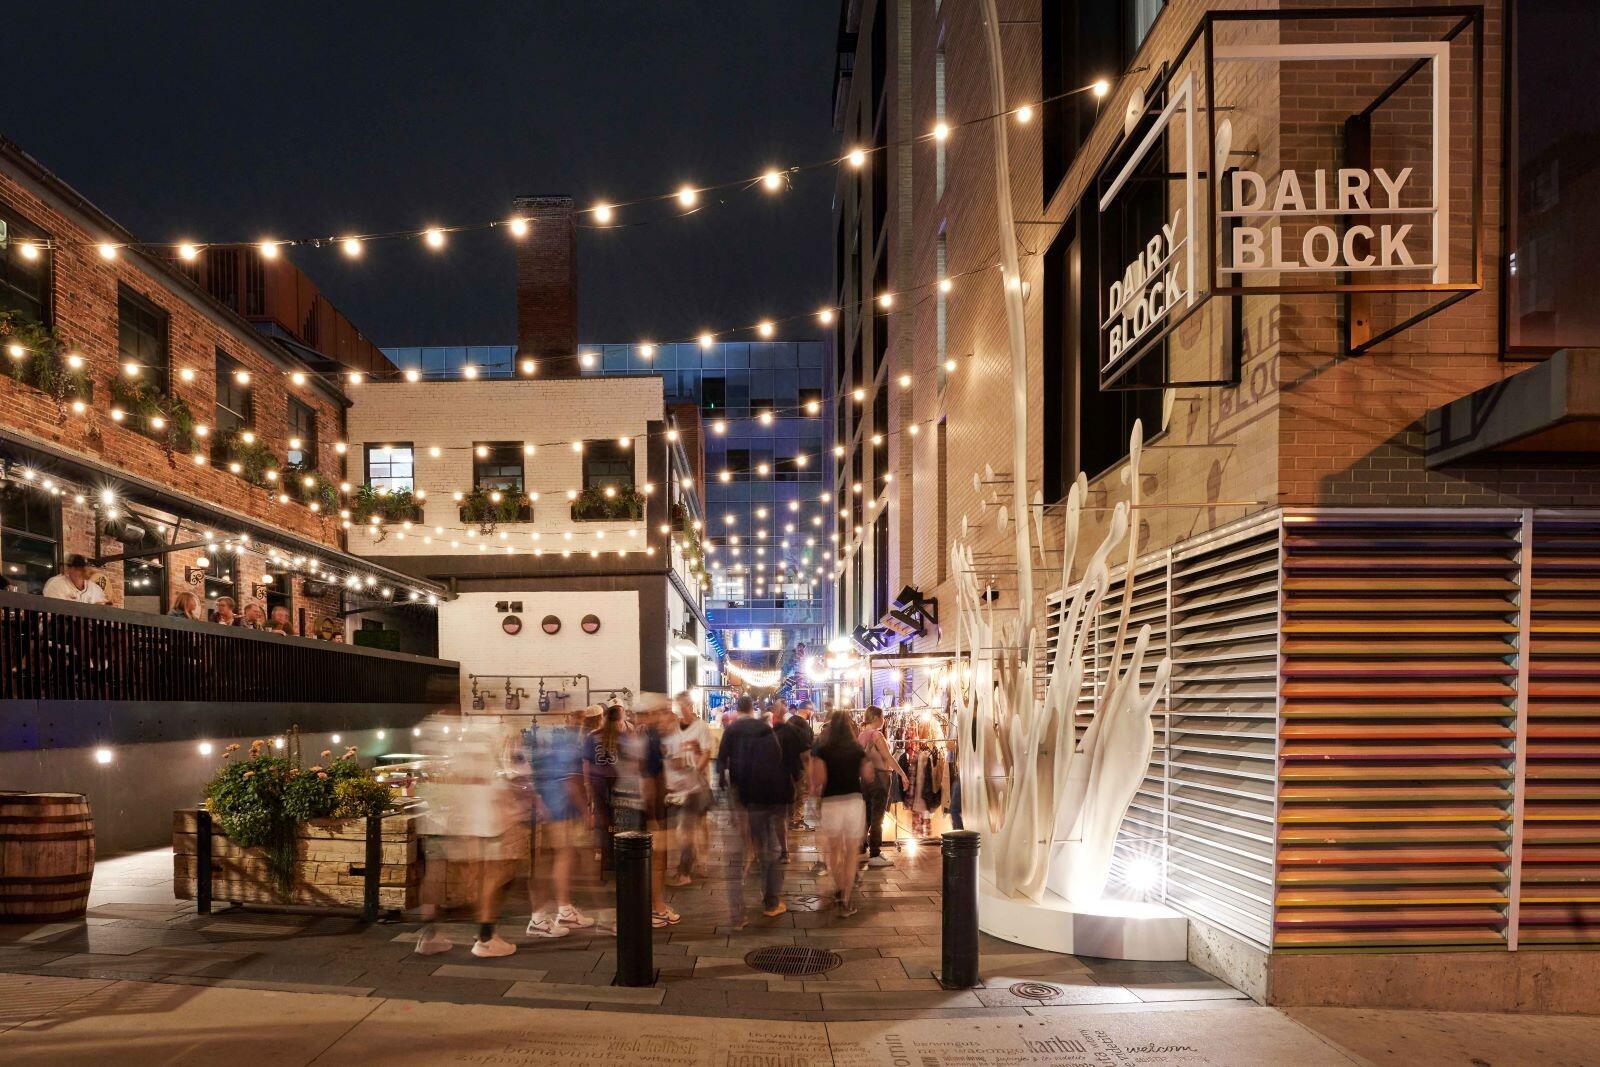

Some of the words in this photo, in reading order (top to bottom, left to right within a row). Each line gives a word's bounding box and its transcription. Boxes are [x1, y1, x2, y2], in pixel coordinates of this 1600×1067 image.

[1232, 167, 1413, 212] DAIRY
[1110, 208, 1181, 318] DAIRY
[1232, 224, 1414, 268] BLOCK
[1110, 260, 1182, 362] BLOCK
[1020, 1035, 1087, 1053] karibu
